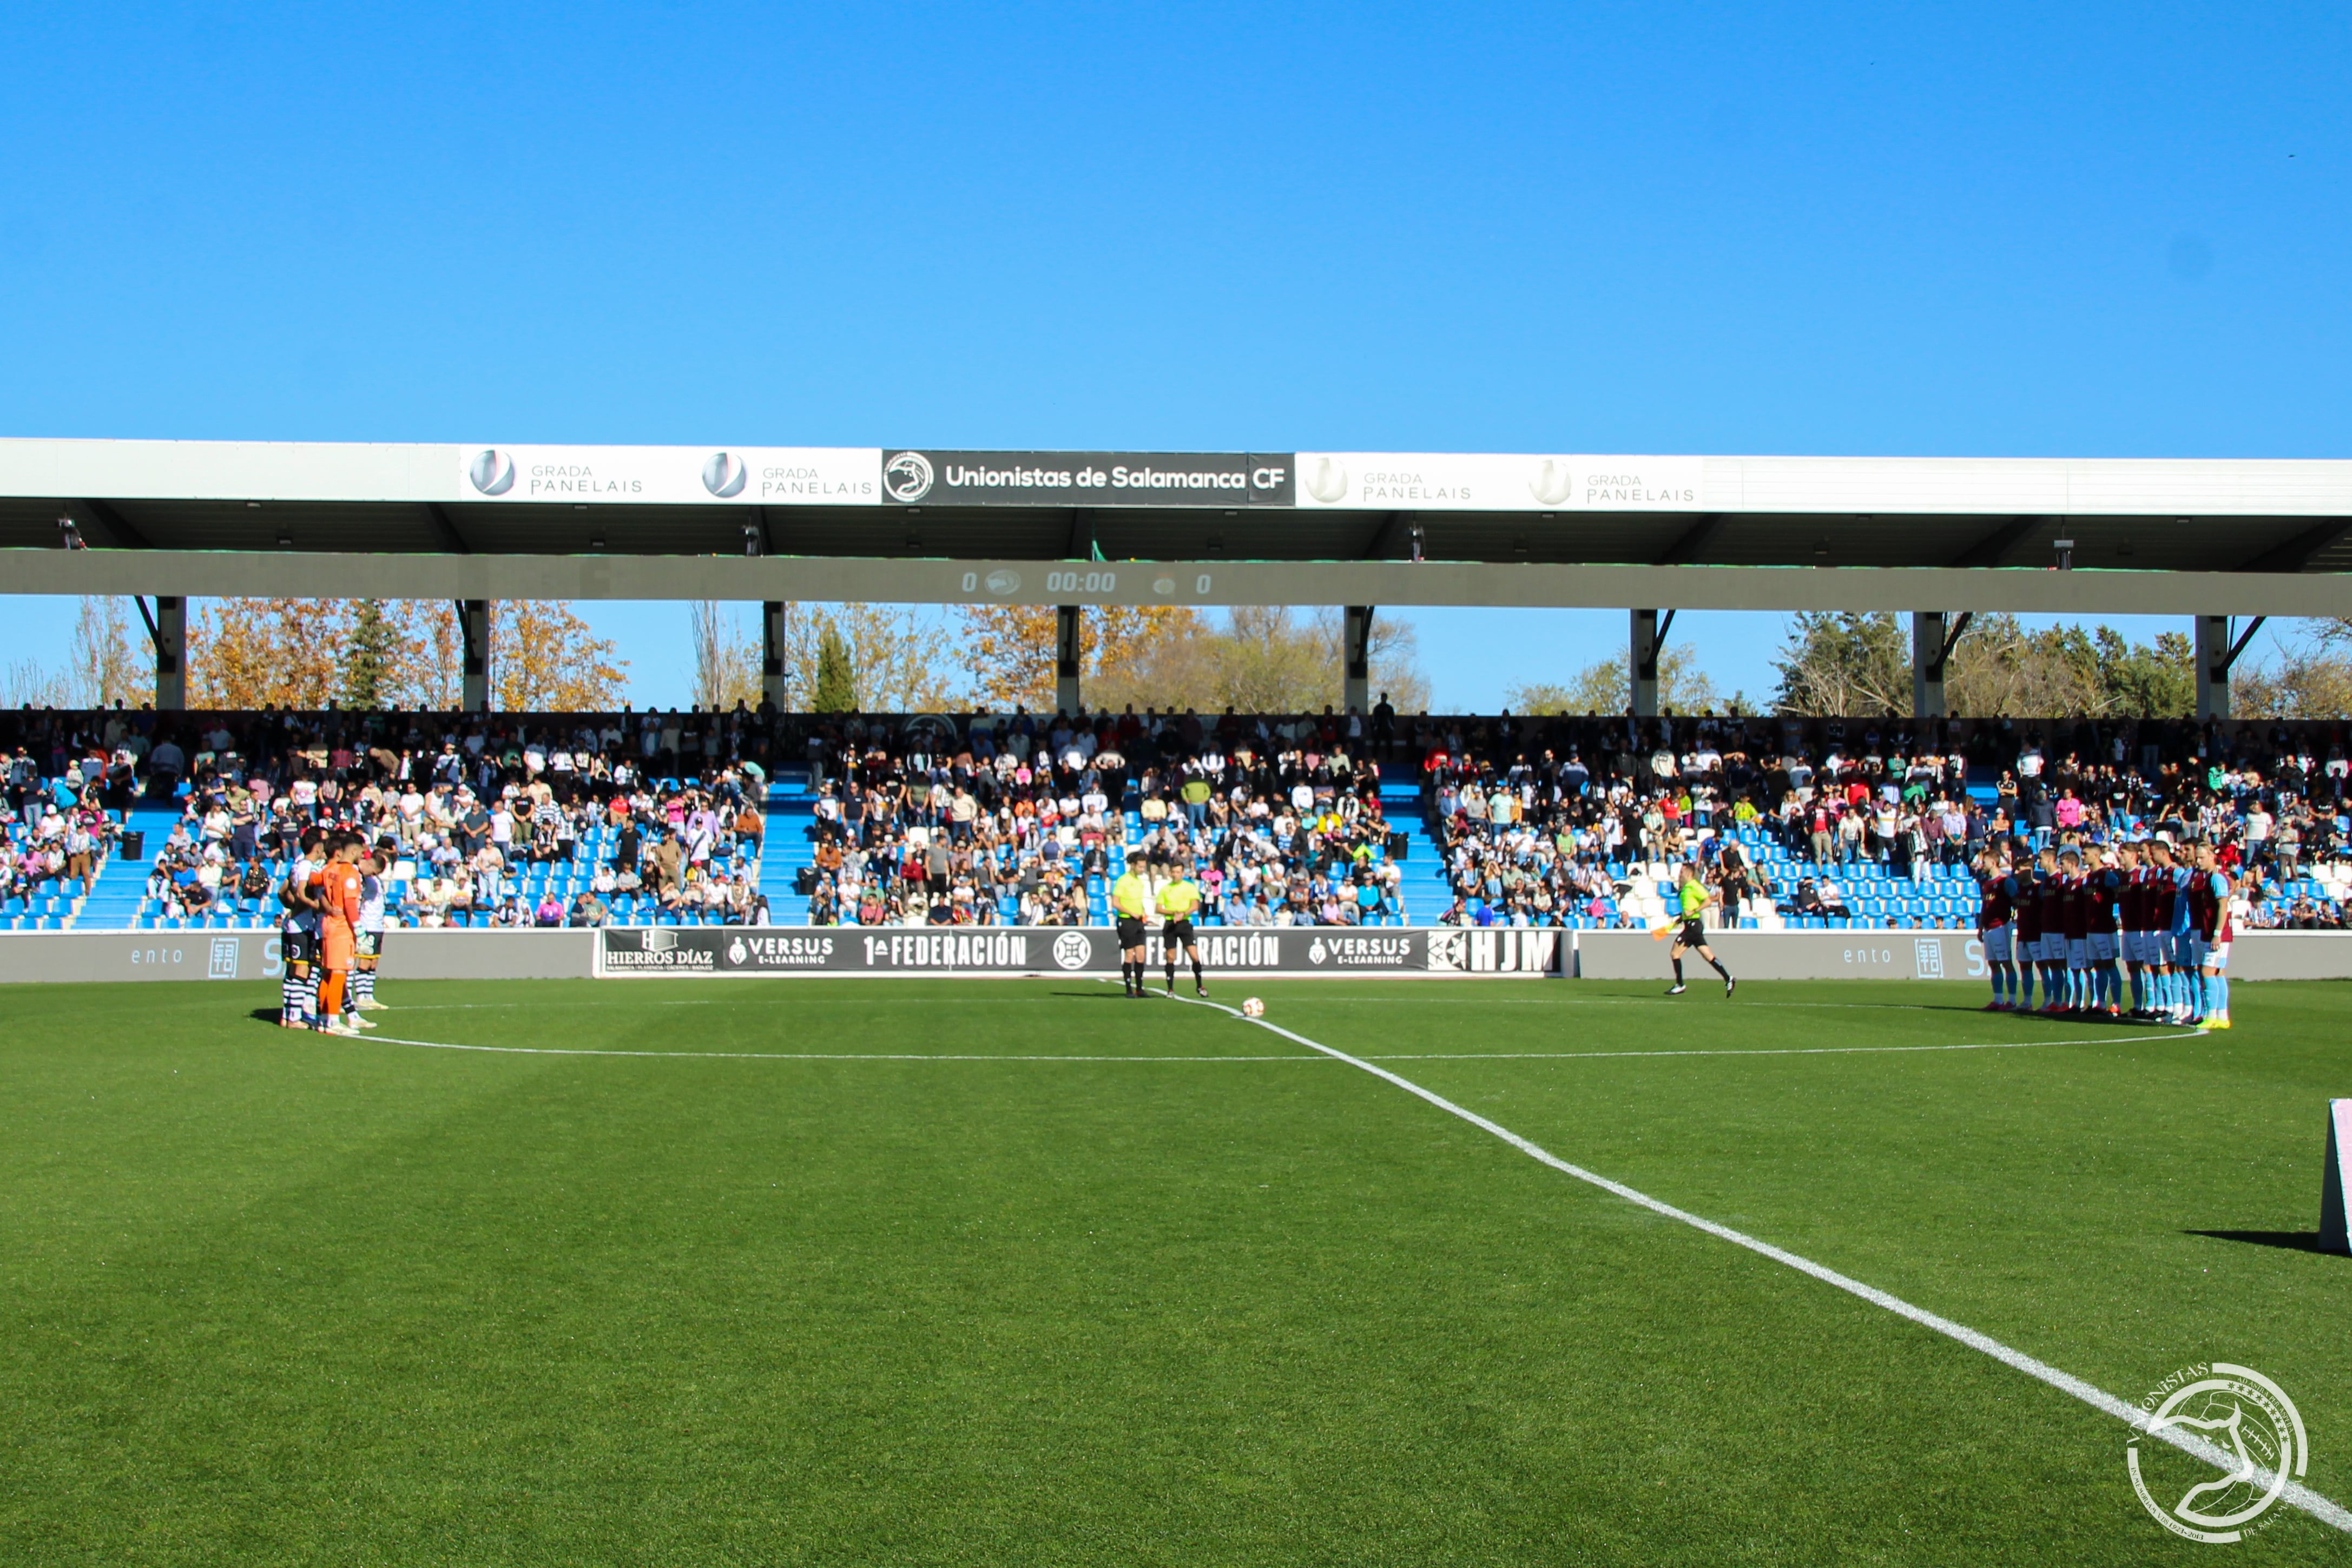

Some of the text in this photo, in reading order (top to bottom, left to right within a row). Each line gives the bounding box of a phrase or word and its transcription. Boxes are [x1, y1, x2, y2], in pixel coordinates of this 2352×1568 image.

[531, 465, 592, 477] GRADA
[762, 467, 819, 479] GRADA
[946, 465, 1285, 489] Unionistas de Salamanca CF
[1364, 472, 1423, 484] GRADA
[531, 479, 642, 495] PANELAIS
[1587, 475, 1642, 486] GRADA
[762, 482, 872, 497] PANELAIS
[1363, 487, 1471, 502] PANELAIS
[1587, 489, 1694, 504] PANELAIS
[961, 572, 1211, 595] 0 00:00 0
[748, 937, 833, 955] VERSUS
[892, 931, 1026, 966] FEDERACIÓN
[1328, 938, 1411, 956] VERSUS
[1471, 931, 1554, 971] HJM
[131, 948, 182, 963] ento
[607, 948, 713, 965] HIERROS DÍAZ
[758, 955, 826, 964] E-LEARNING
[1338, 955, 1402, 964] E-LEARNING
[1843, 948, 1890, 963] ento
